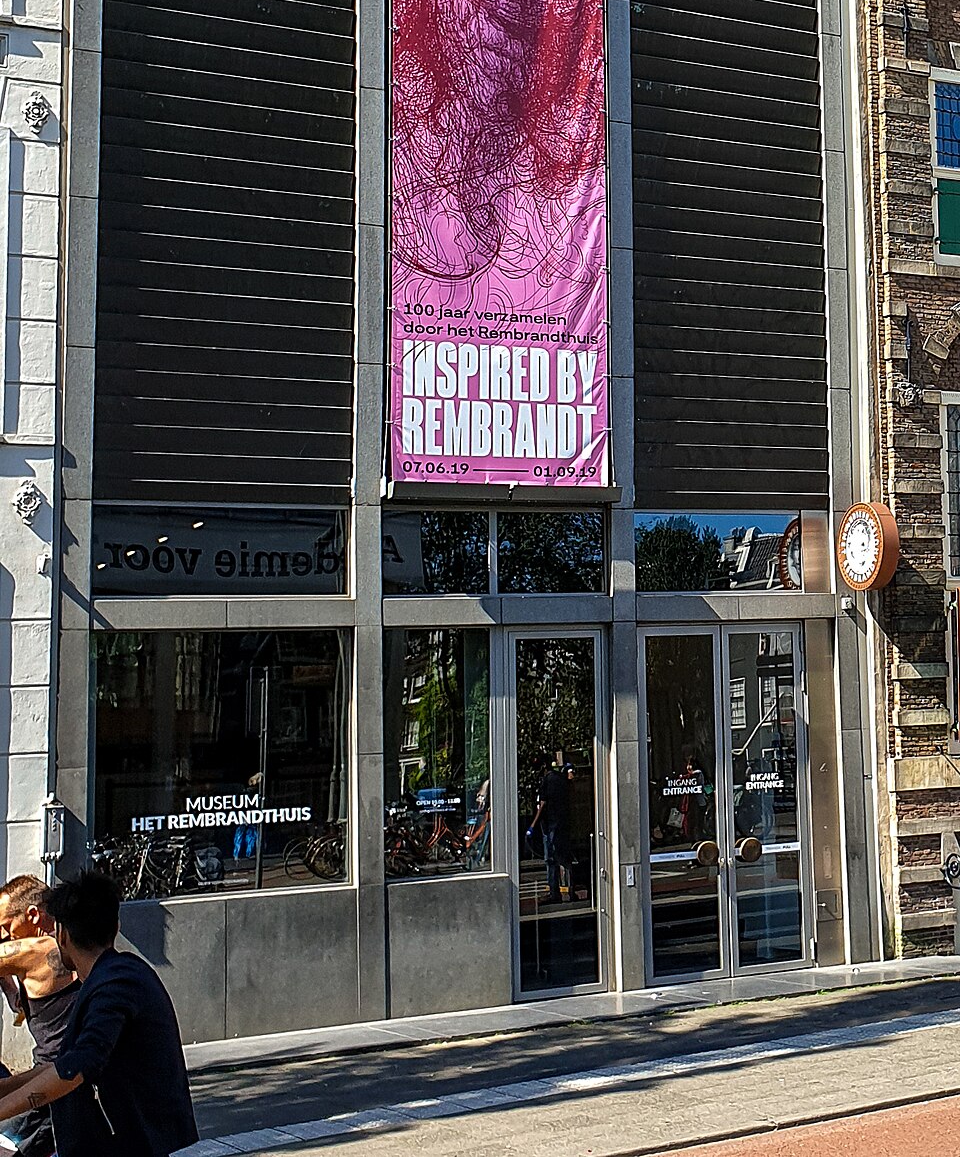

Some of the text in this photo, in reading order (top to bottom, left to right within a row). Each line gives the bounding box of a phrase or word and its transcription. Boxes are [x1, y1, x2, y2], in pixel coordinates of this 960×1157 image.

[404, 303, 567, 326] 100 jaar verzamelen
[404, 323, 599, 344] door het Rembrandthuis
[402, 339, 598, 404] INSPIRED BY
[402, 397, 597, 459] REMBRANDT
[402, 460, 597, 478] 07.06.19 01.09.19
[667, 778, 697, 787] INGANG
[746, 780, 784, 790] ENTRANCE
[751, 773, 779, 781] INGANG
[663, 786, 702, 796] ENTRANCE
[186, 794, 260, 812] MUSEUM
[131, 807, 311, 832] HET REMBRANDTHUIS
